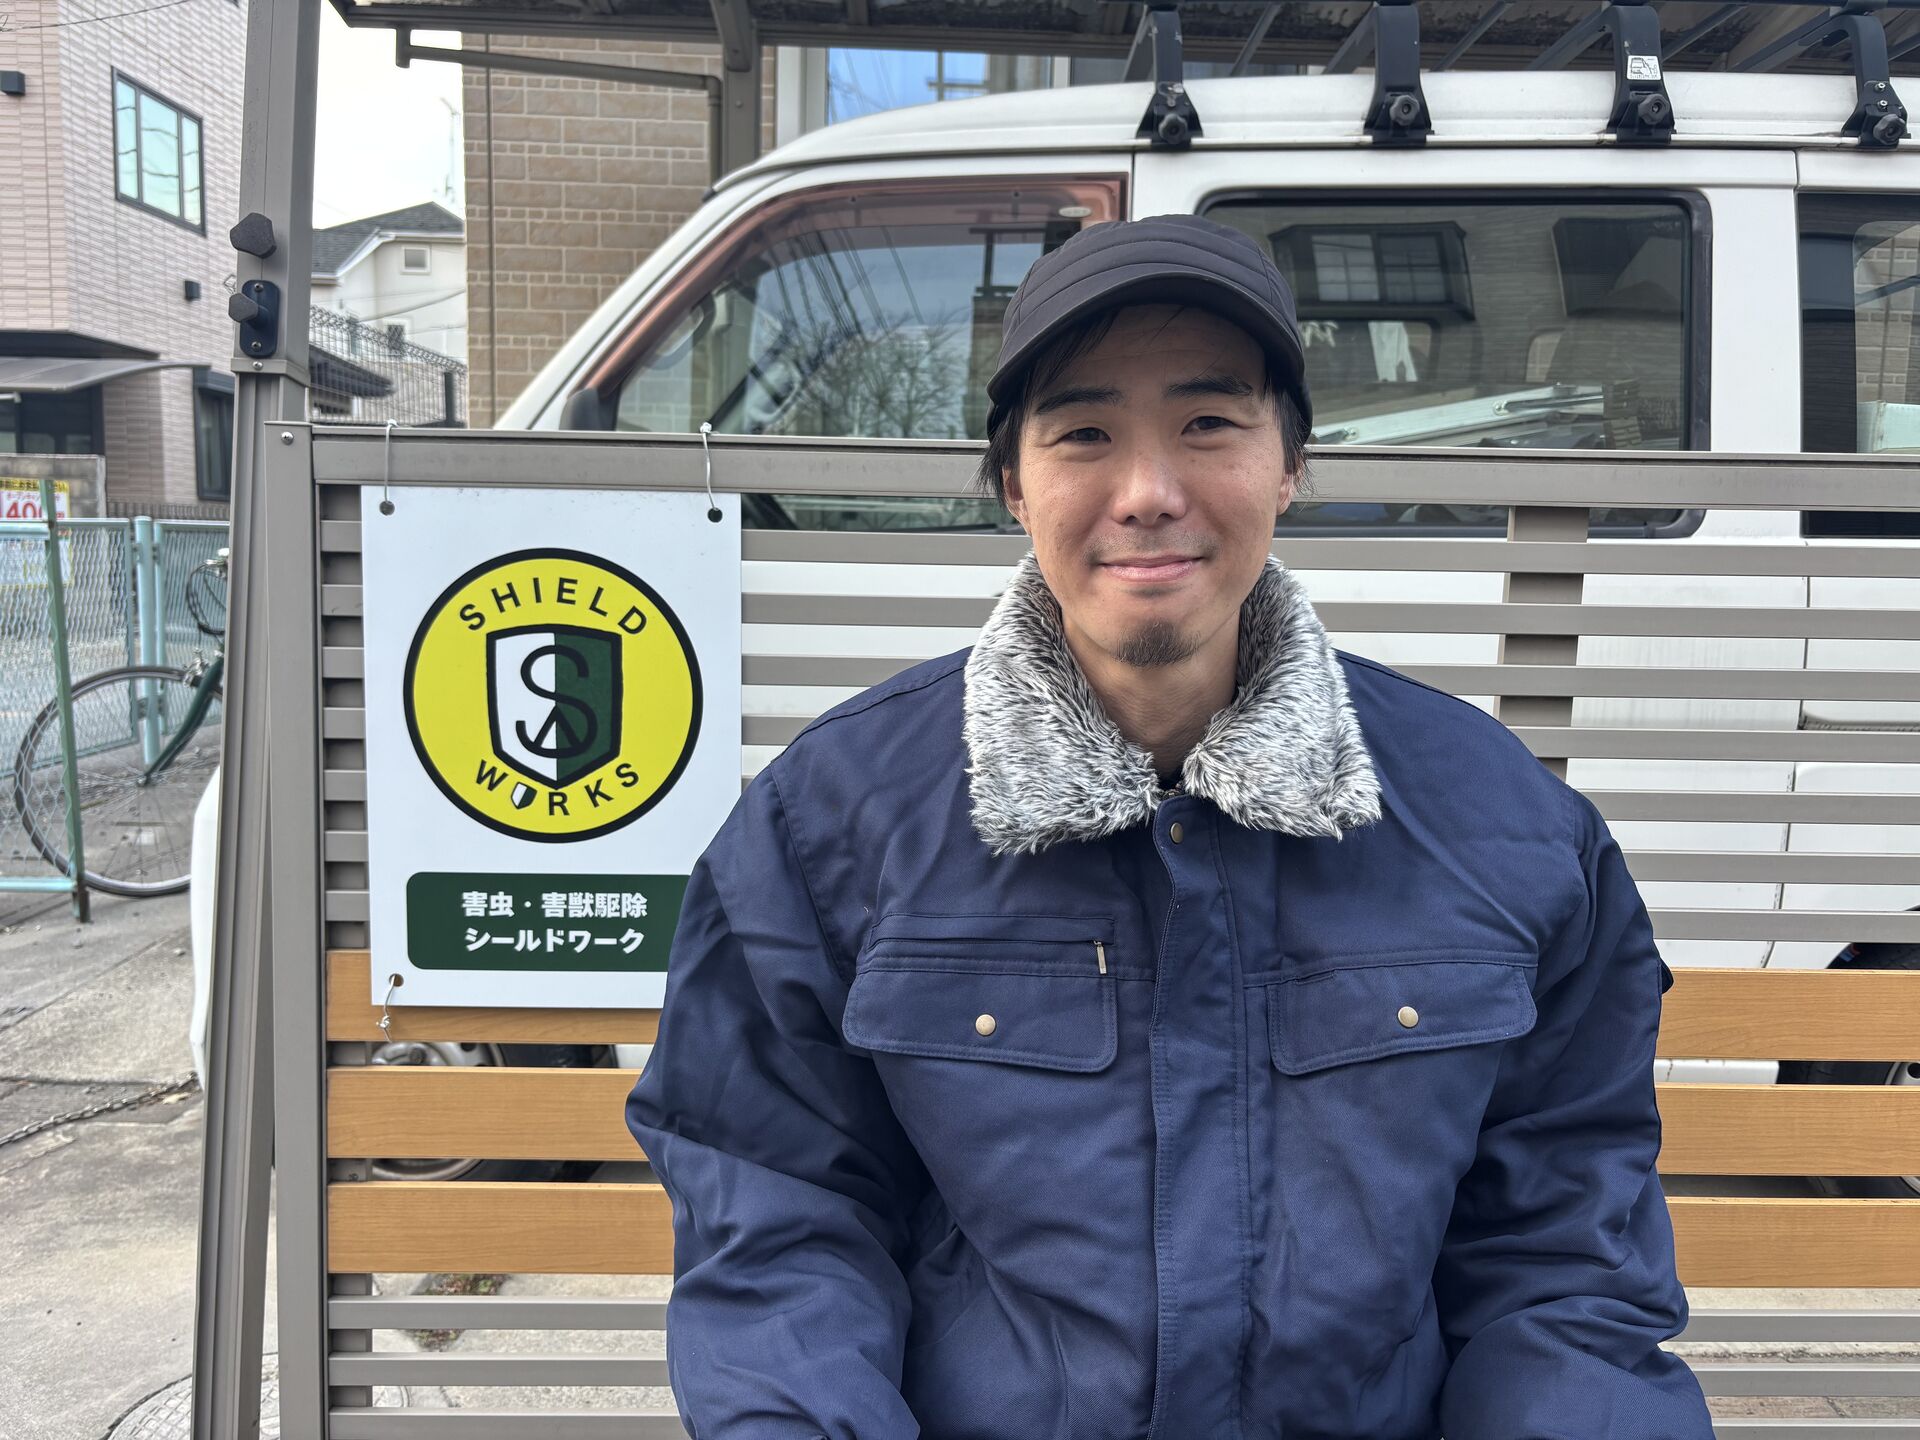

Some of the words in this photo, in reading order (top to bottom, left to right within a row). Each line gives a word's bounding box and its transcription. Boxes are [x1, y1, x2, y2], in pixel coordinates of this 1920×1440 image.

[459, 577, 647, 635] SHIELD
[461, 890, 648, 919] 害虫・害獣駆除
[464, 927, 645, 954] シールドワーク
